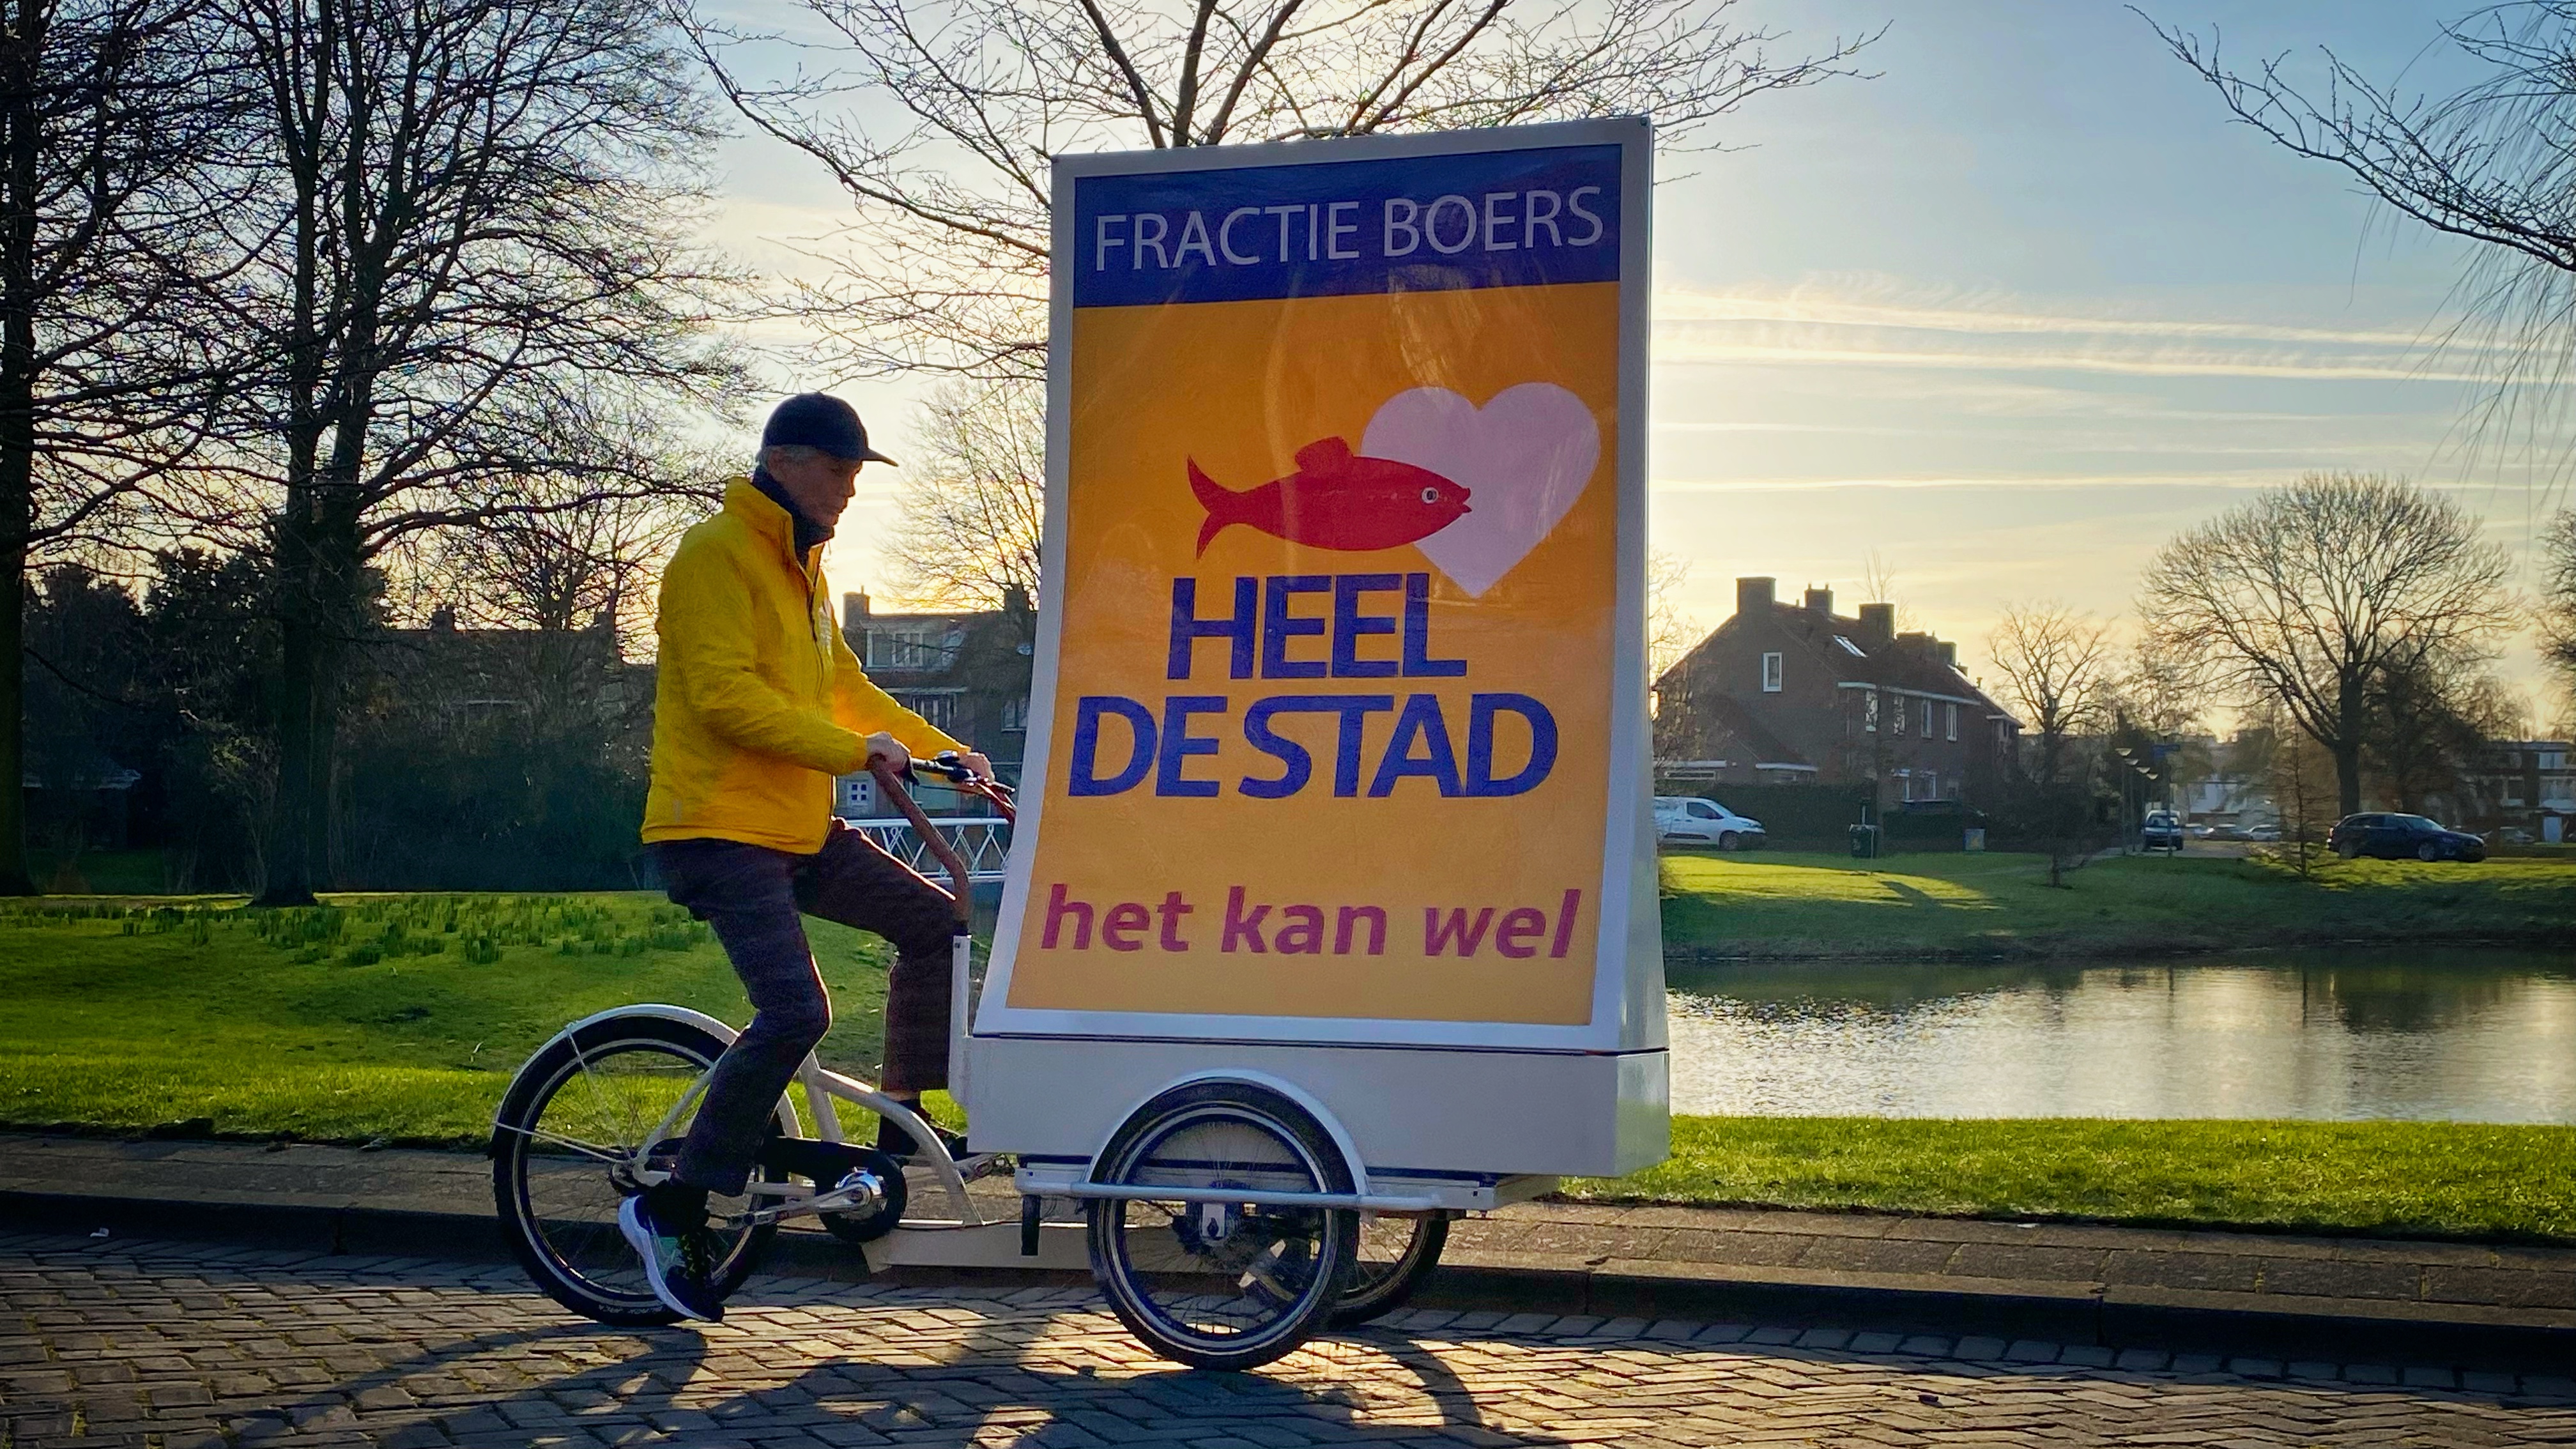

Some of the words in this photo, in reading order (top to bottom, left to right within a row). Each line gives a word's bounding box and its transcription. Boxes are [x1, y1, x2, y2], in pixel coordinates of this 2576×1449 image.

[1096, 201, 1360, 272] FRACTIE
[1384, 185, 1604, 257] BOERS
[1167, 572, 1467, 680] HEEL
[1041, 883, 1193, 951] het
[1221, 885, 1387, 954] kan
[1425, 888, 1581, 958] wel
